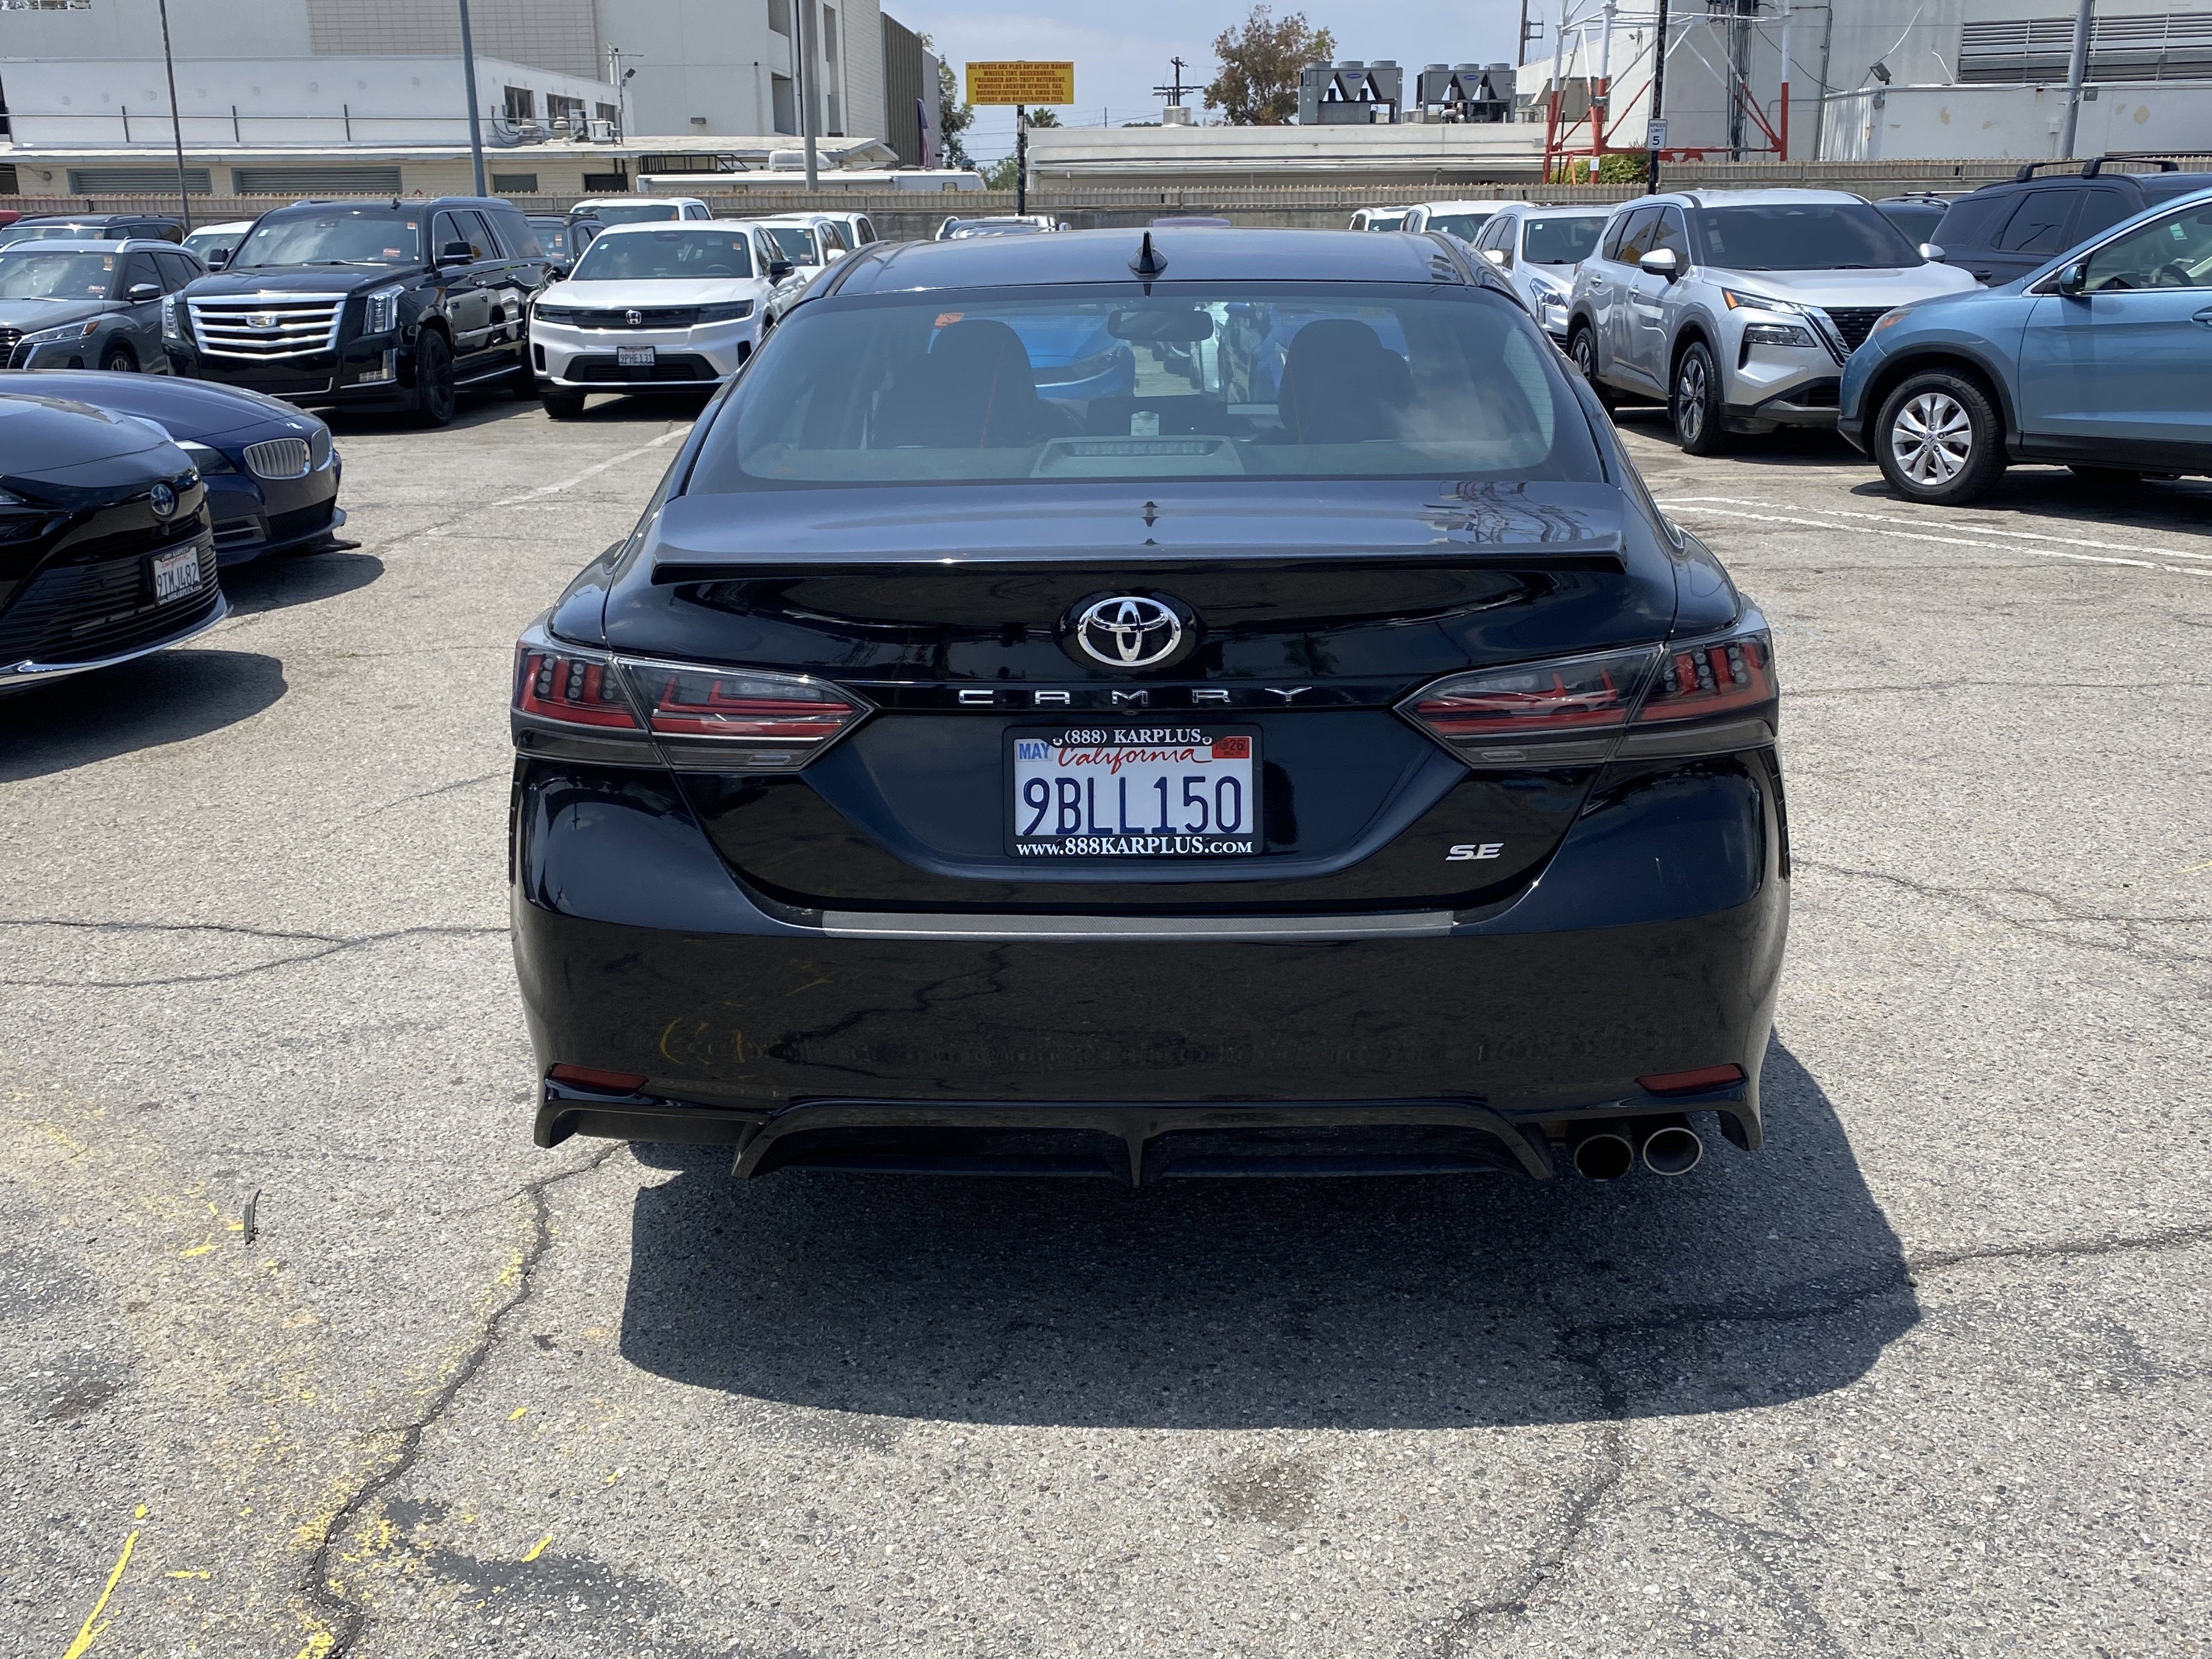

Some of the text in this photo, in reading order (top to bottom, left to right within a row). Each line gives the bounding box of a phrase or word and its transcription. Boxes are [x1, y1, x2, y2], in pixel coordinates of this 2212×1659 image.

[1652, 136, 1660, 145] 5
[958, 686, 1312, 707] CAMRY
[1064, 728, 1201, 744] (888) KARPLUS
[1019, 742, 1050, 760] MAY
[1058, 747, 1212, 775] California
[1022, 776, 1242, 837] 9BLL150
[1444, 843, 1504, 861] SE
